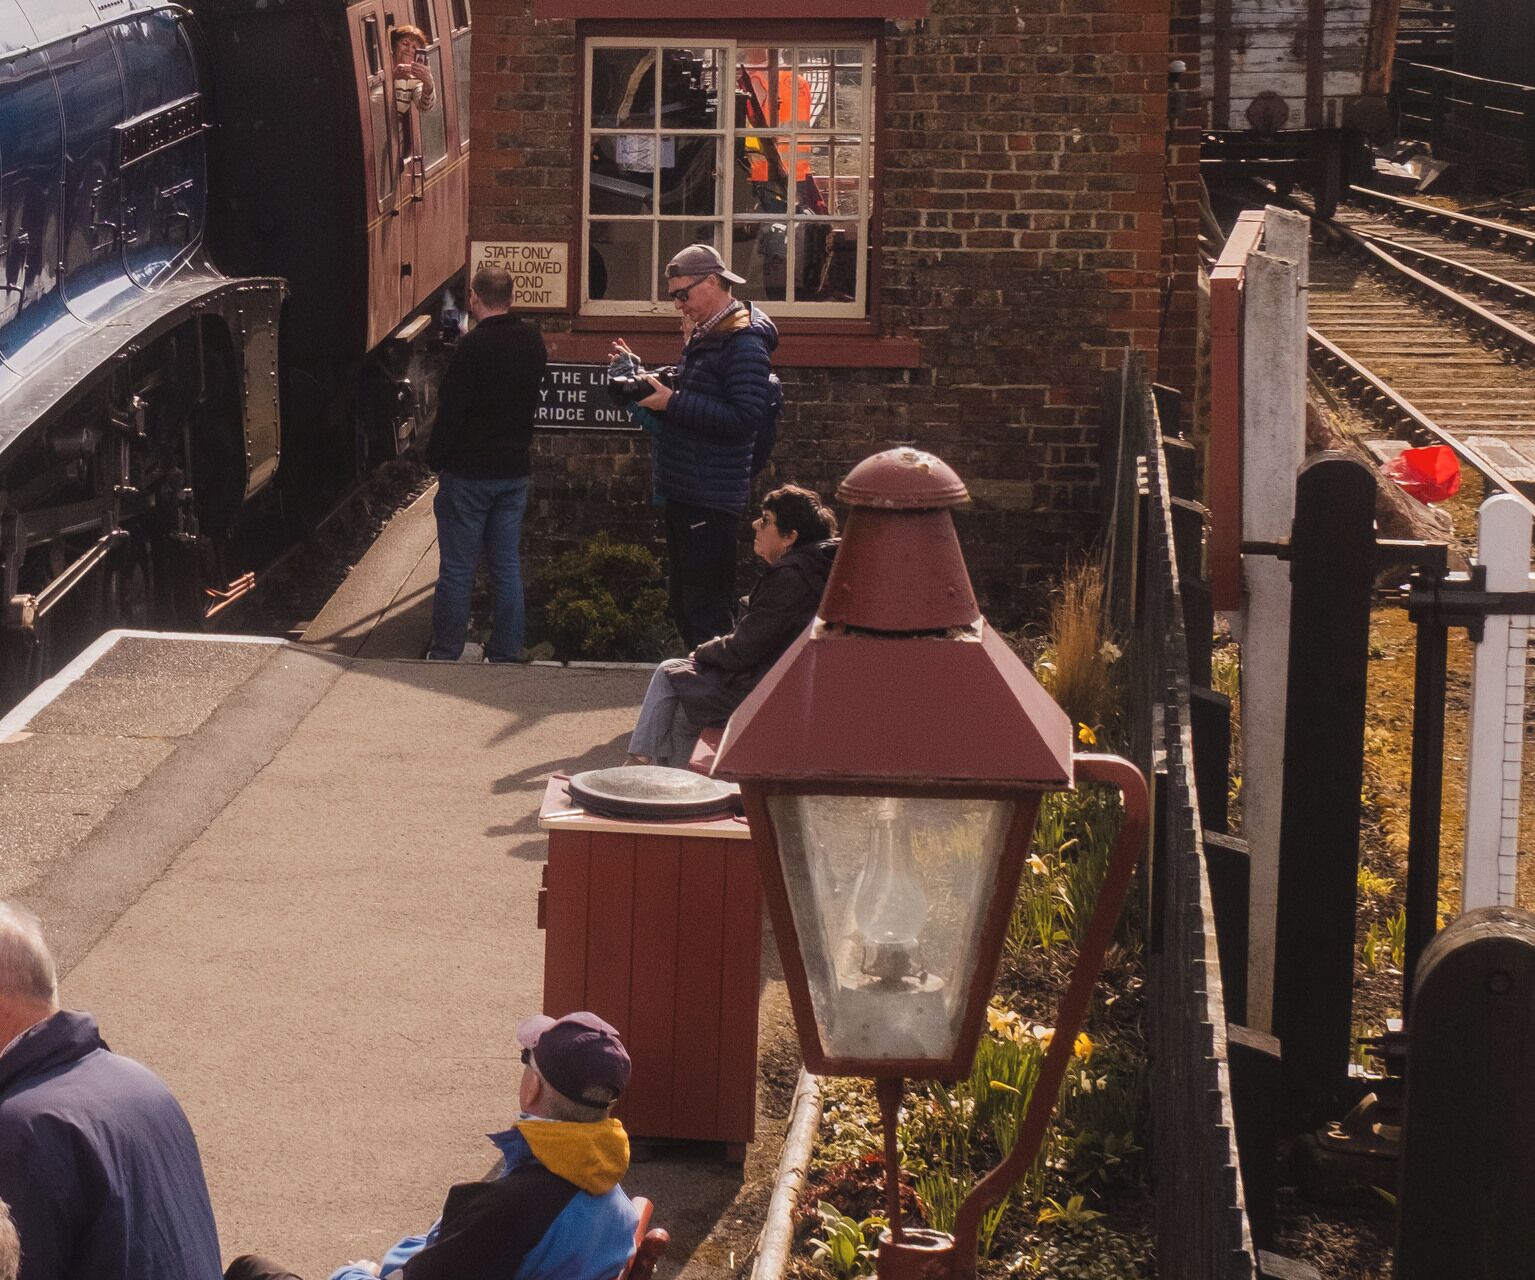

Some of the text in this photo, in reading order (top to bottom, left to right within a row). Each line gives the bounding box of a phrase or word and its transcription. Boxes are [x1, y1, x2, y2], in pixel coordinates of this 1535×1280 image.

[484, 246, 553, 259] STAFF ONLY
[504, 261, 562, 274] ALLOWED
[513, 276, 544, 288] OND
[514, 290, 552, 303] POINT
[551, 372, 581, 384] THE
[556, 390, 587, 402] THE
[534, 407, 634, 422] RIDGE ONLY
